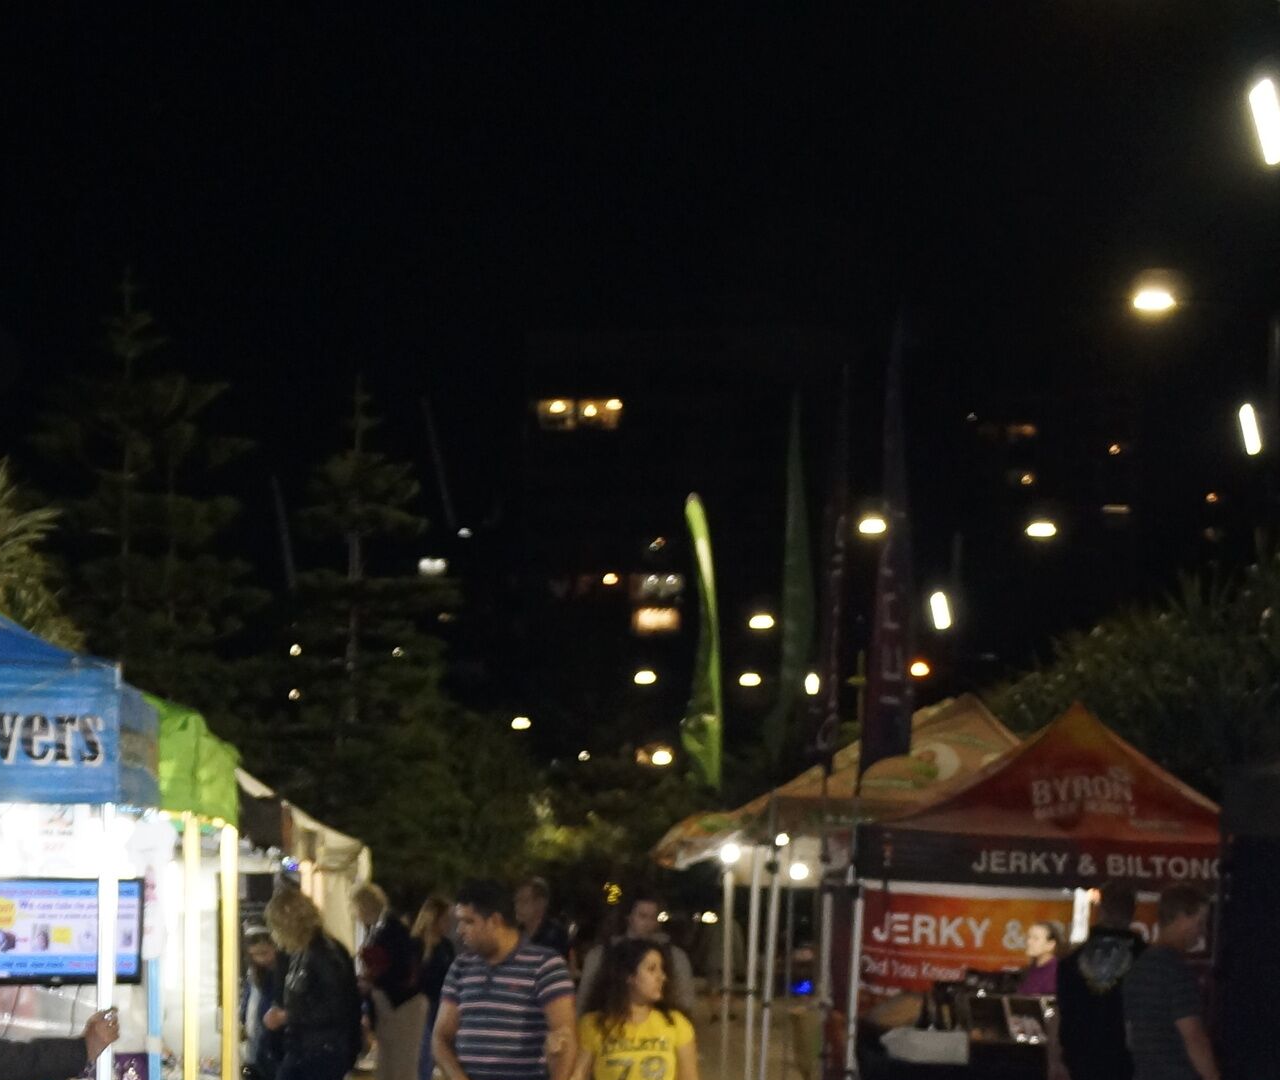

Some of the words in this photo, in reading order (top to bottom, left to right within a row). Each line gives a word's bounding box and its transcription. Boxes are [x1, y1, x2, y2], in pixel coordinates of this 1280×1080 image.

[971, 849, 1069, 877] JERKY
[1077, 853, 1098, 876] &
[872, 912, 991, 948] JERKY
